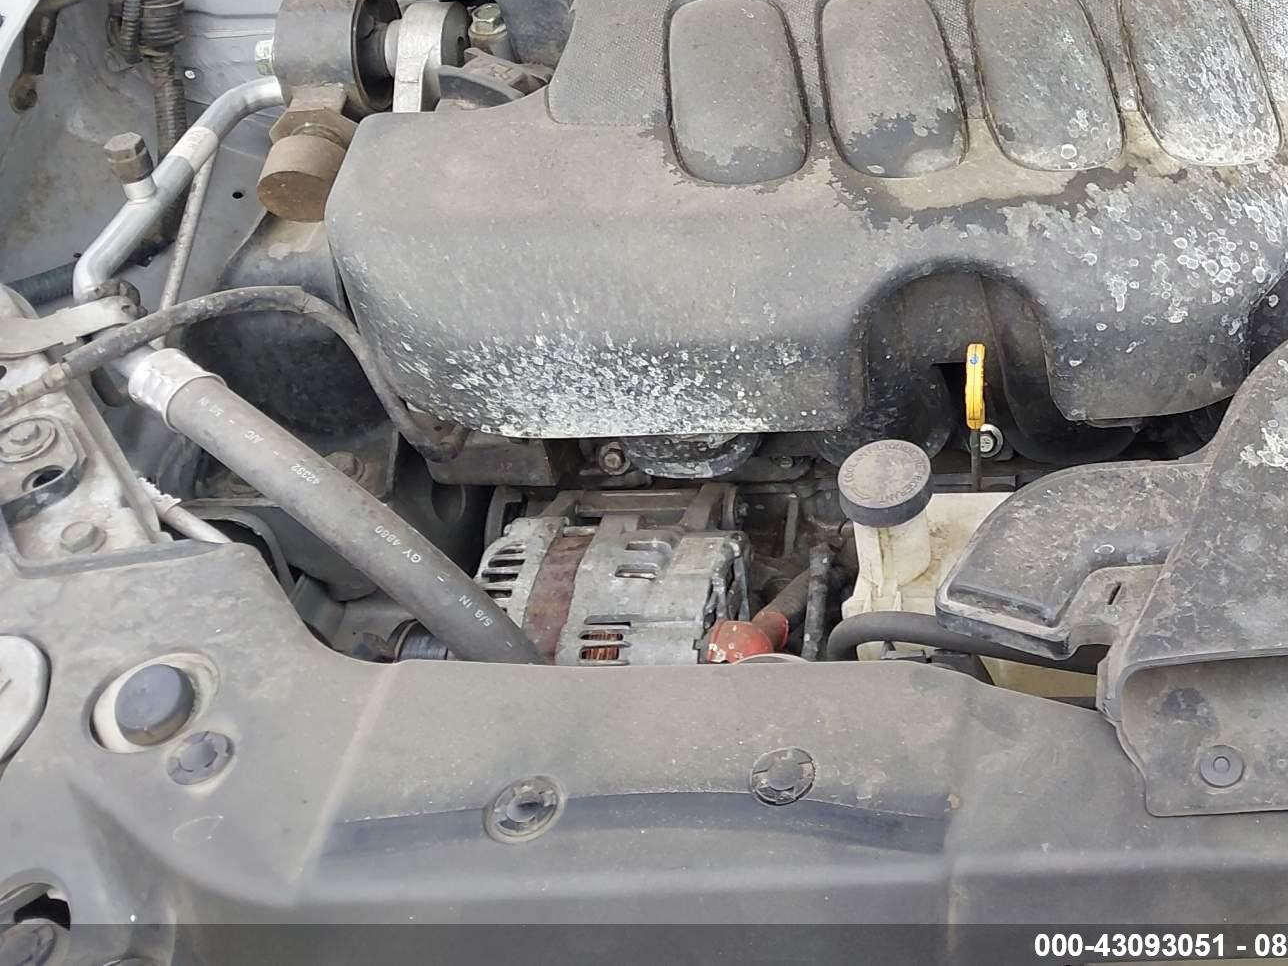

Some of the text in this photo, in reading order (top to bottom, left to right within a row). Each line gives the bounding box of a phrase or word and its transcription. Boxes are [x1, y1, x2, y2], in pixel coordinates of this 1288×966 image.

[402, 549, 421, 564] GY
[458, 595, 473, 609] IN
[473, 609, 494, 627] 5/8
